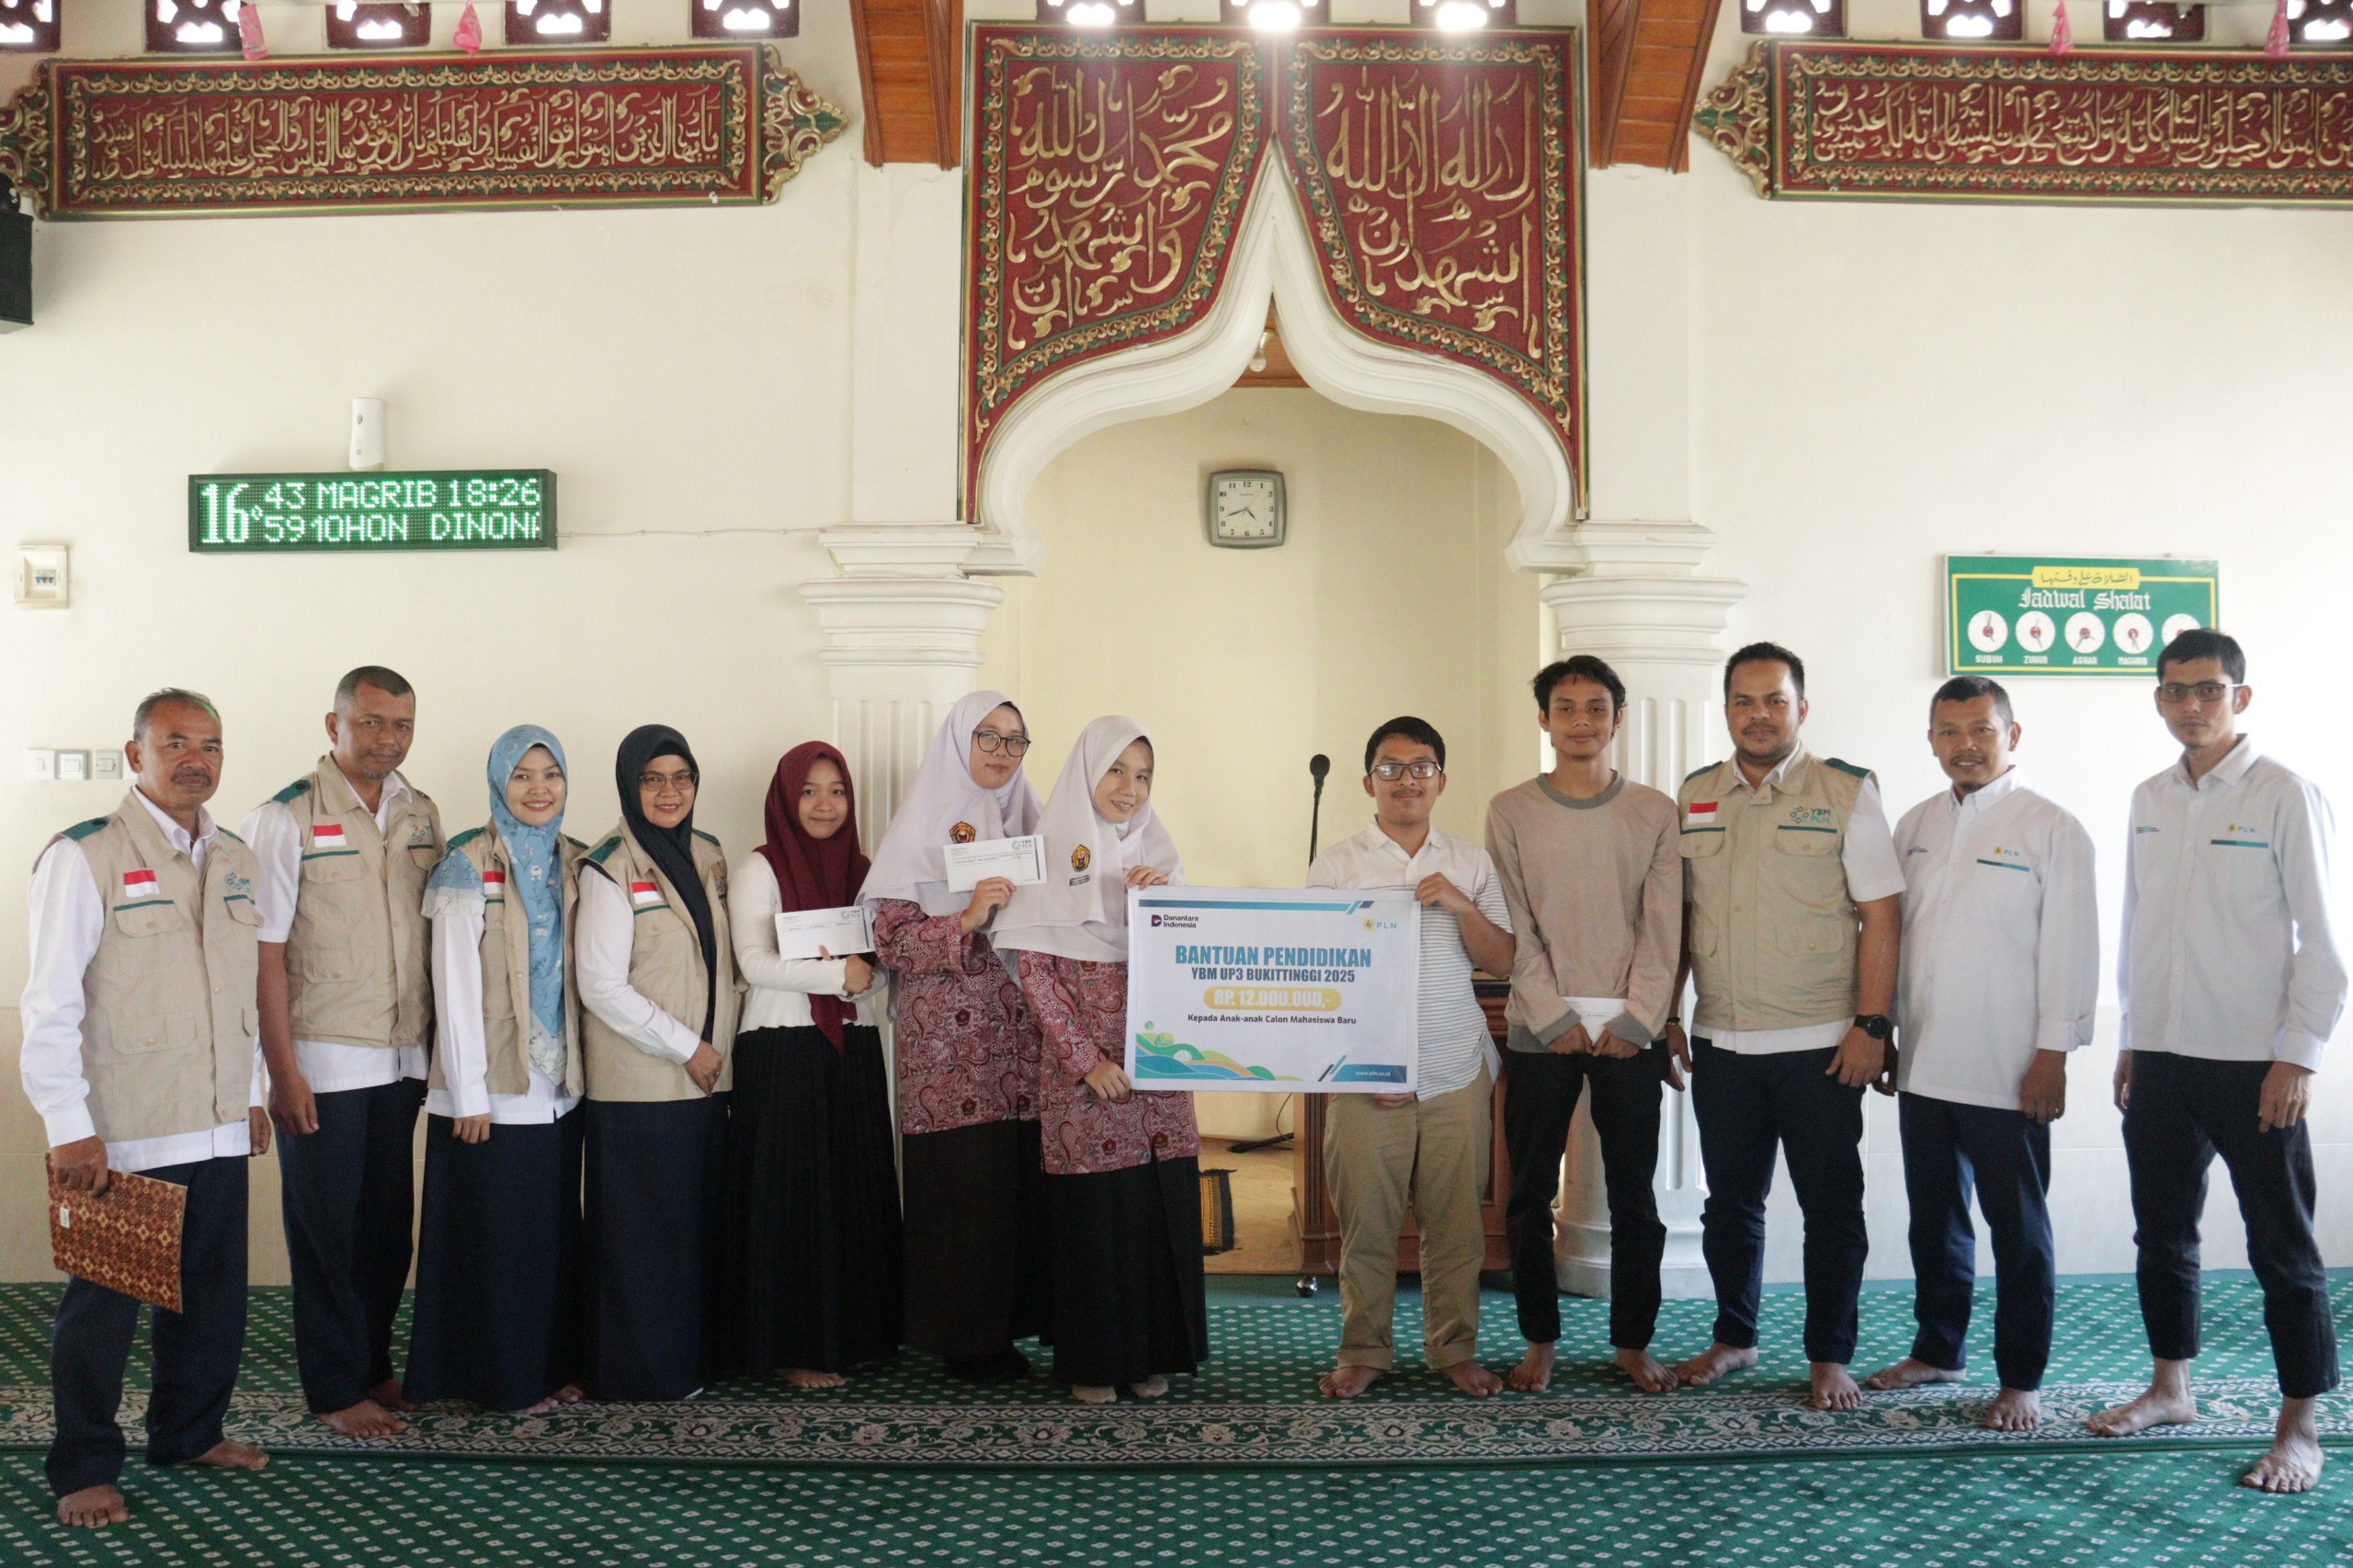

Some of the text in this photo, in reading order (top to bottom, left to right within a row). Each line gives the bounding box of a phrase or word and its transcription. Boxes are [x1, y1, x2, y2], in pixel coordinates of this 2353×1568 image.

[265, 478, 540, 510] 43 MAGRIB 18:26
[265, 515, 306, 543] 59
[2018, 586, 2152, 611] Jadwal Shalat
[1163, 914, 1199, 922] Danantara
[1175, 945, 1371, 968] BANTUAN PENDIDIKAN
[1191, 967, 1356, 983] YBM UP3 BUKITTINGGI 2025
[1213, 989, 1235, 1006] RP.
[1188, 1014, 1357, 1025] Kepada Anak-anak Calon Mahasiswa Baru
